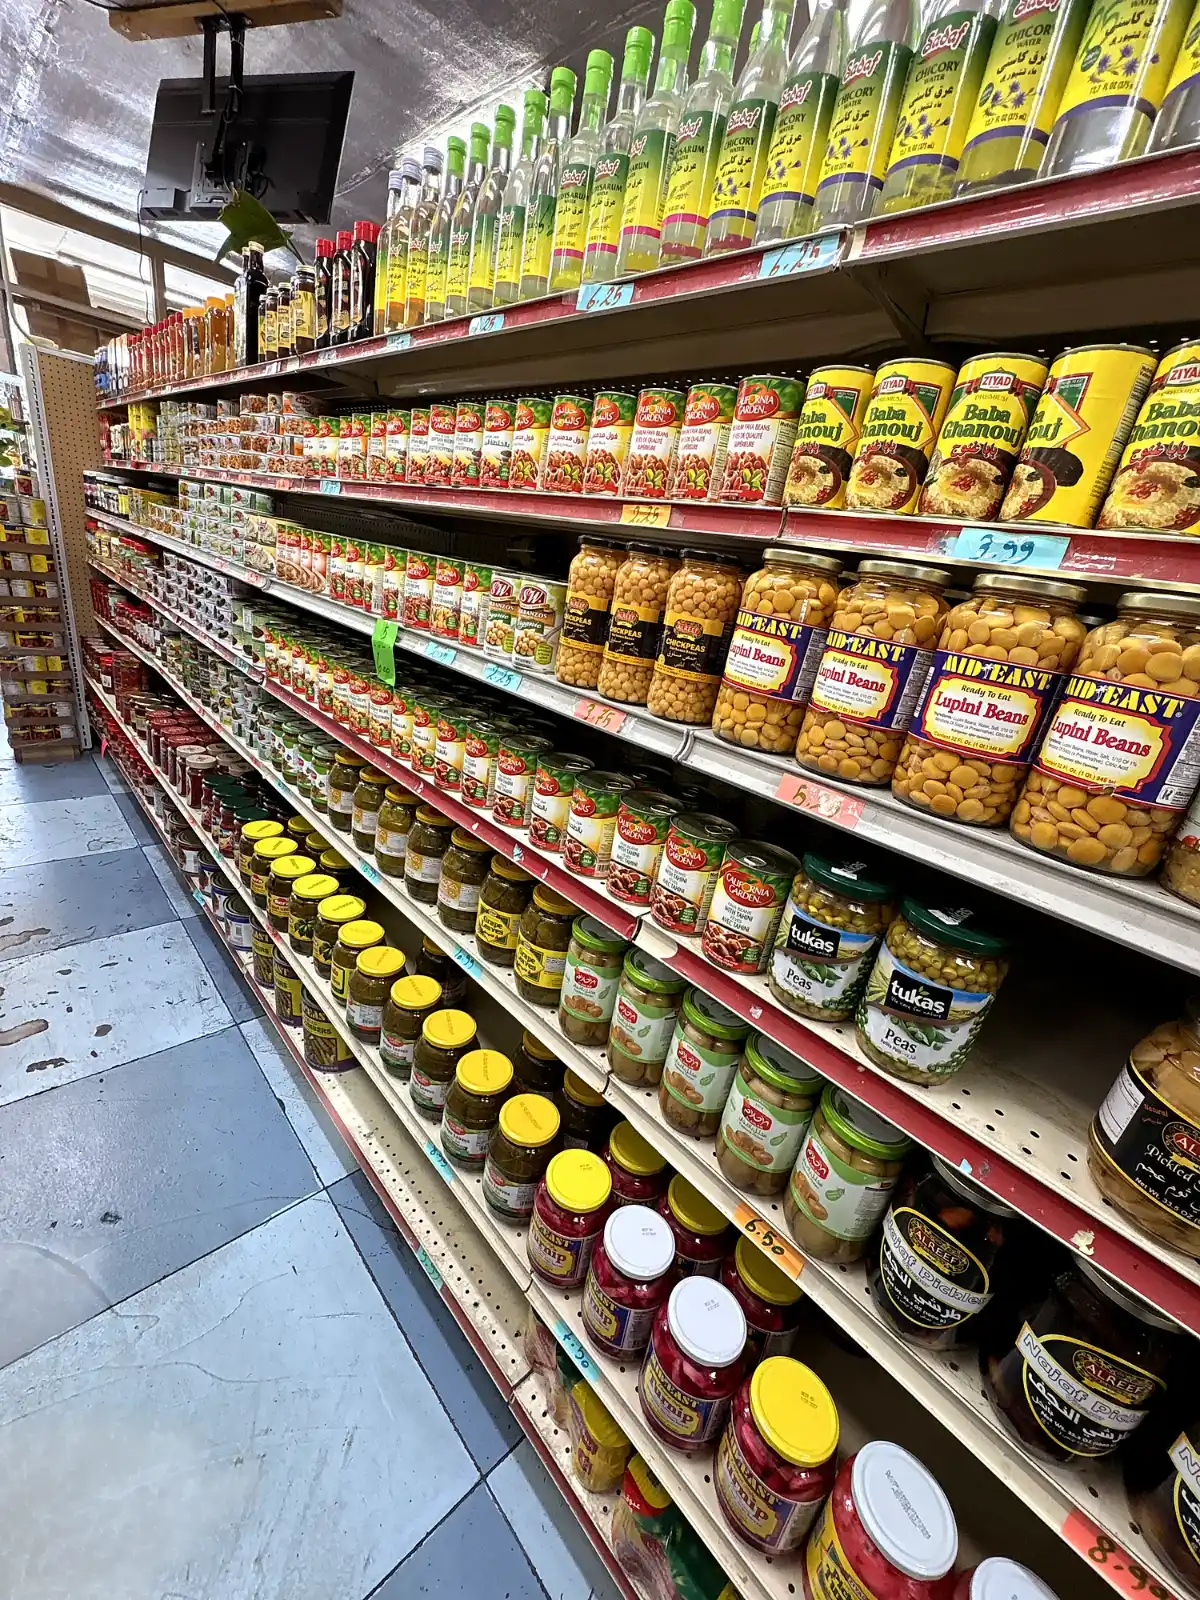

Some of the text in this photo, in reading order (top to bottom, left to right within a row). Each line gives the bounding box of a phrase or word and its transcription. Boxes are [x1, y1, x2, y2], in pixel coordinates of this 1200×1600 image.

[921, 21, 970, 58] Sadaf
[842, 50, 882, 85] Sadaf
[914, 60, 961, 83] CHICORY
[778, 80, 812, 112] Sadaf
[727, 106, 761, 135] Sadaf
[880, 377, 906, 391] ZIYAD
[982, 375, 1012, 387] ZIYAD
[869, 406, 907, 424] Baba
[961, 404, 1012, 424] Baba
[797, 422, 844, 447] anouj
[942, 420, 1025, 450] Ghanouj
[968, 533, 1036, 565] 3.99
[756, 617, 803, 640] EAST
[666, 637, 706, 653] CHICKPEAS
[760, 639, 771, 648] Eat
[849, 635, 906, 663] EAST
[752, 648, 786, 668] Beans
[832, 655, 869, 672] Ready To Eat
[818, 662, 886, 694] Lupini Beans
[942, 654, 1053, 691] MID EAST
[960, 684, 1012, 702] Ready To Eat
[1101, 684, 1186, 719] EAST
[934, 690, 1030, 726] Lupini Beans
[1073, 708, 1126, 728] Ready To Eat
[1051, 715, 1093, 741] Lupini
[1091, 727, 1152, 758] Beans
[617, 815, 653, 837] CALIFORNIA
[619, 826, 646, 841] GARDEN
[667, 837, 702, 862] CALIFORNIA
[668, 848, 694, 866] GARDEN
[725, 872, 770, 897] CALIFORNIA
[728, 884, 760, 904] GARDEN
[736, 911, 754, 922] TAHINI
[786, 967, 813, 991] Peas
[884, 1027, 918, 1055] Peas
[1143, 1142, 1195, 1182] Pickled
[1134, 1176, 1150, 1190] Net
[743, 1217, 786, 1257] 6.50
[915, 1229, 959, 1265] ALREEF
[1024, 1333, 1089, 1403] Najaf
[1086, 1363, 1143, 1395] ALREEF
